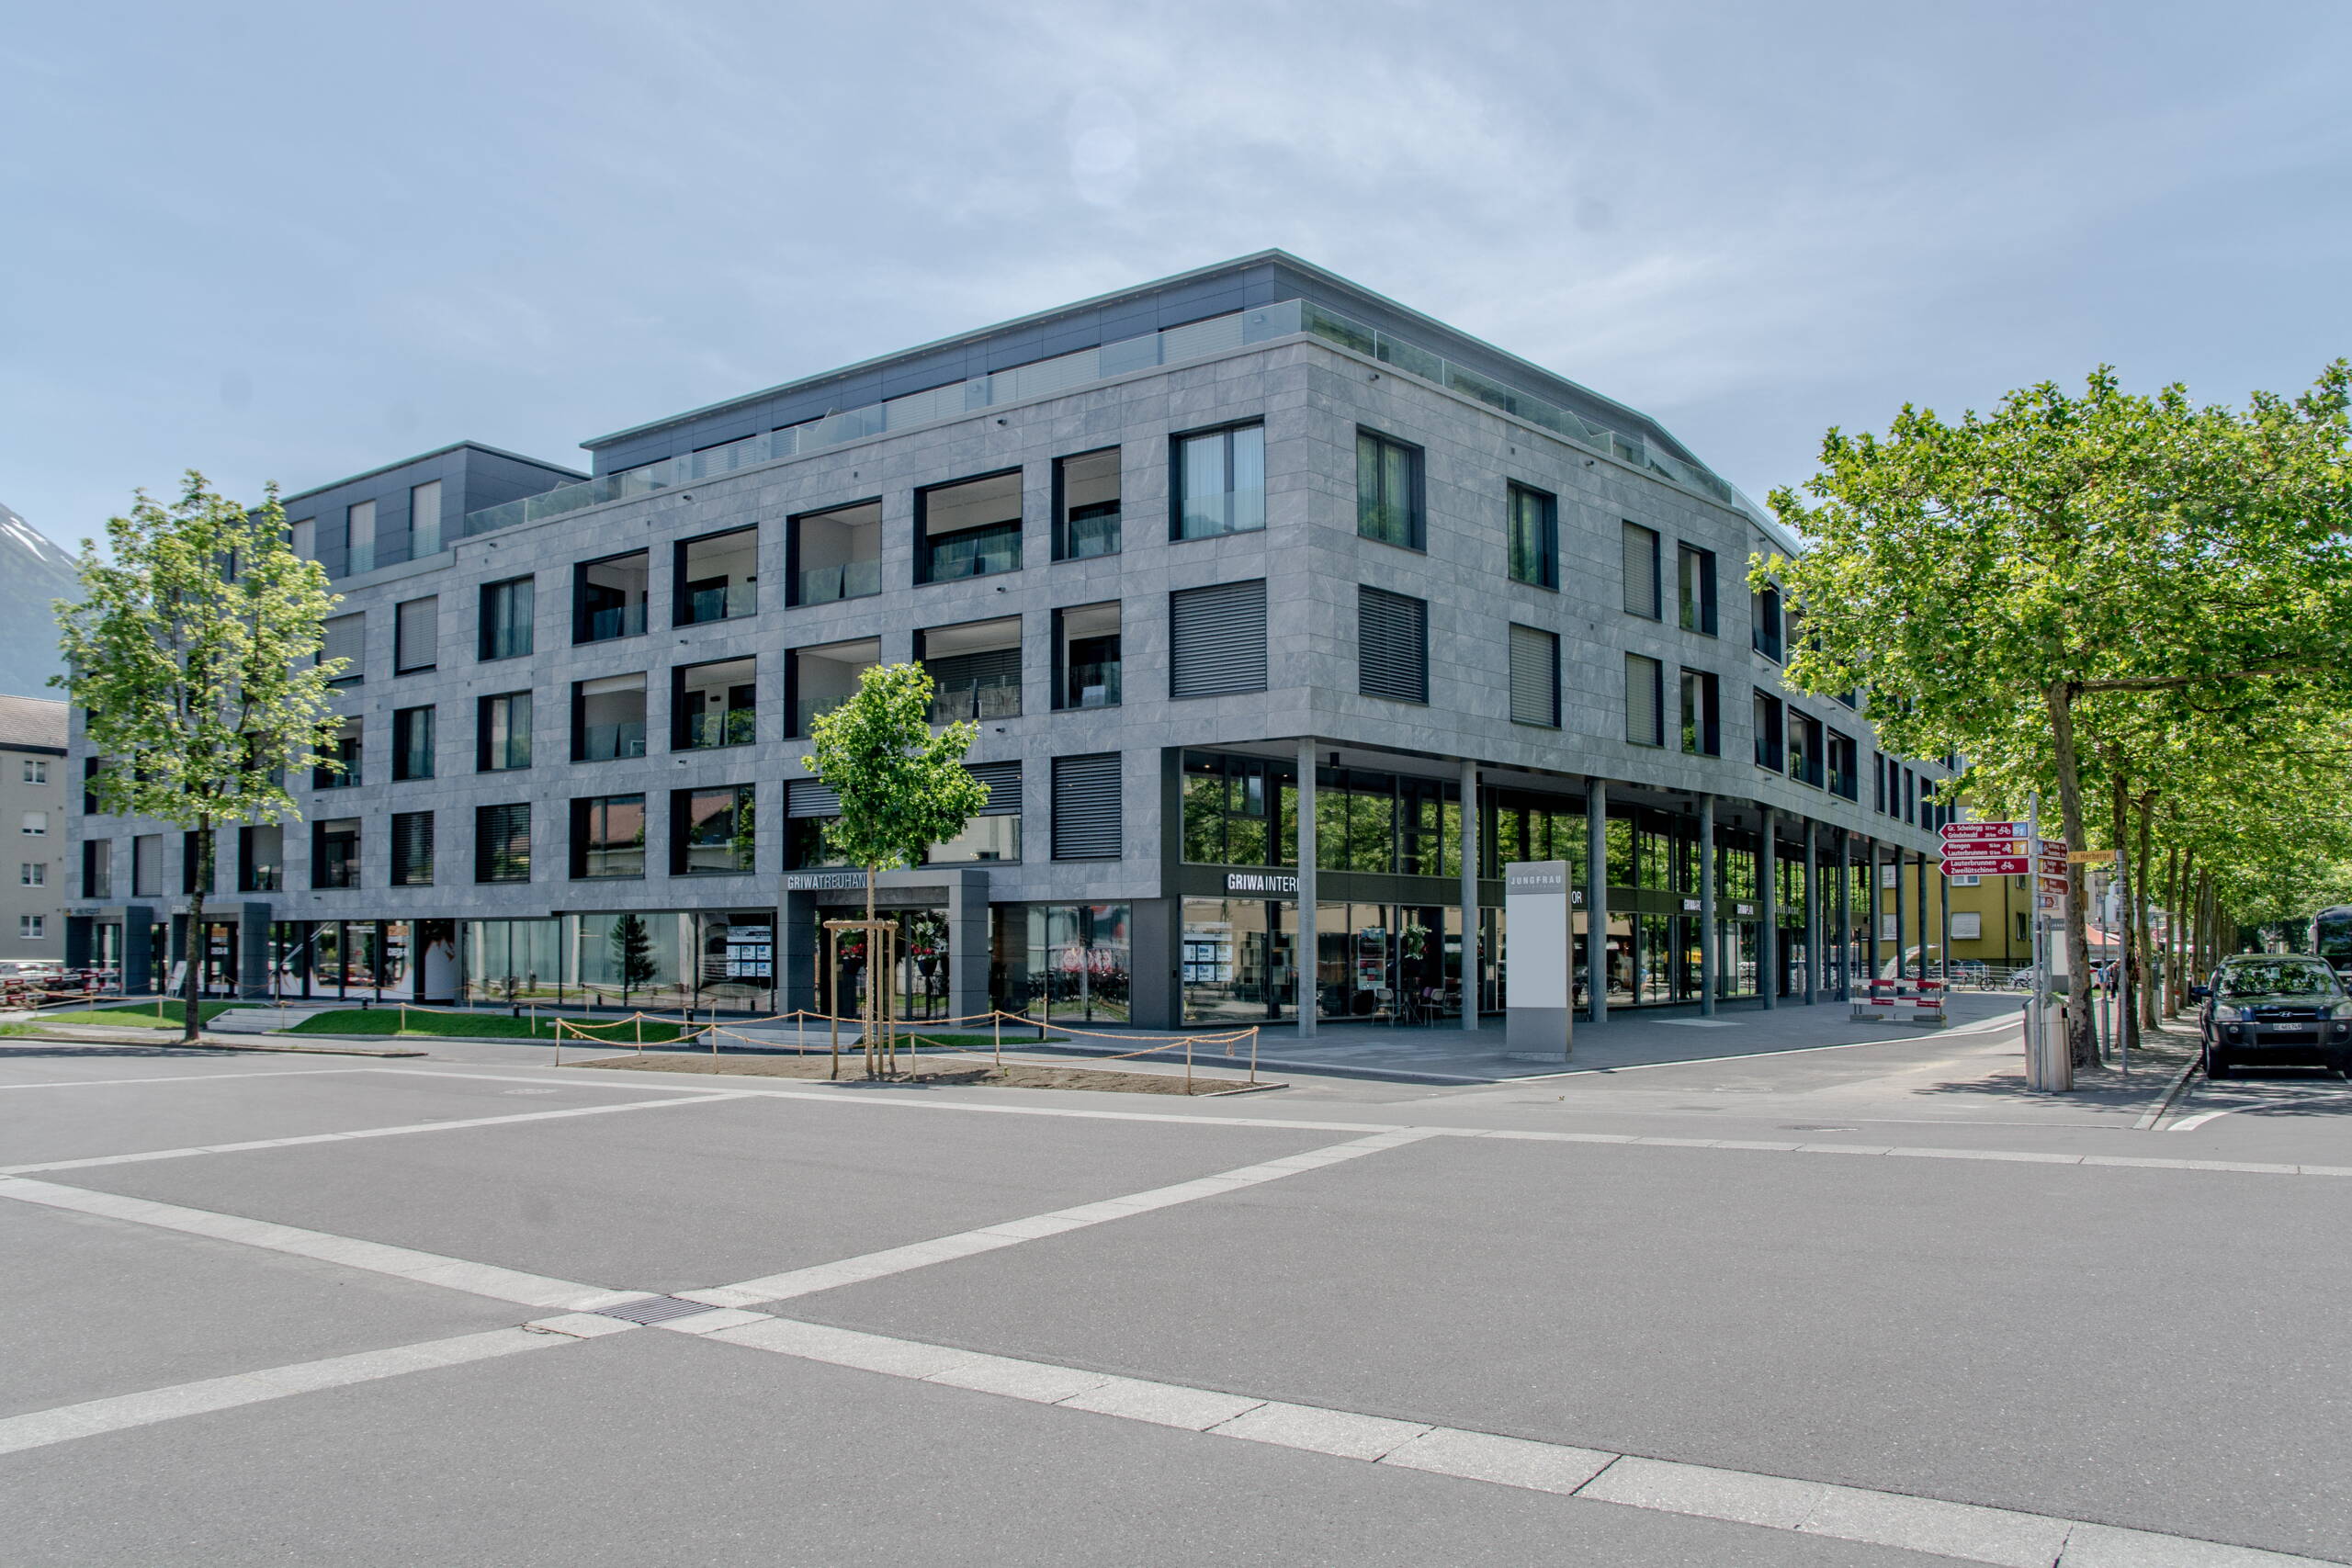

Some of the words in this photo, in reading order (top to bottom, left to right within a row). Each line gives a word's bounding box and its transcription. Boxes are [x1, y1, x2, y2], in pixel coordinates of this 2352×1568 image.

[787, 874, 868, 889] GRIWATREUHAN
[1227, 874, 1299, 892] GRIWAINTERI
[1510, 874, 1561, 885] JUNGFRAU
